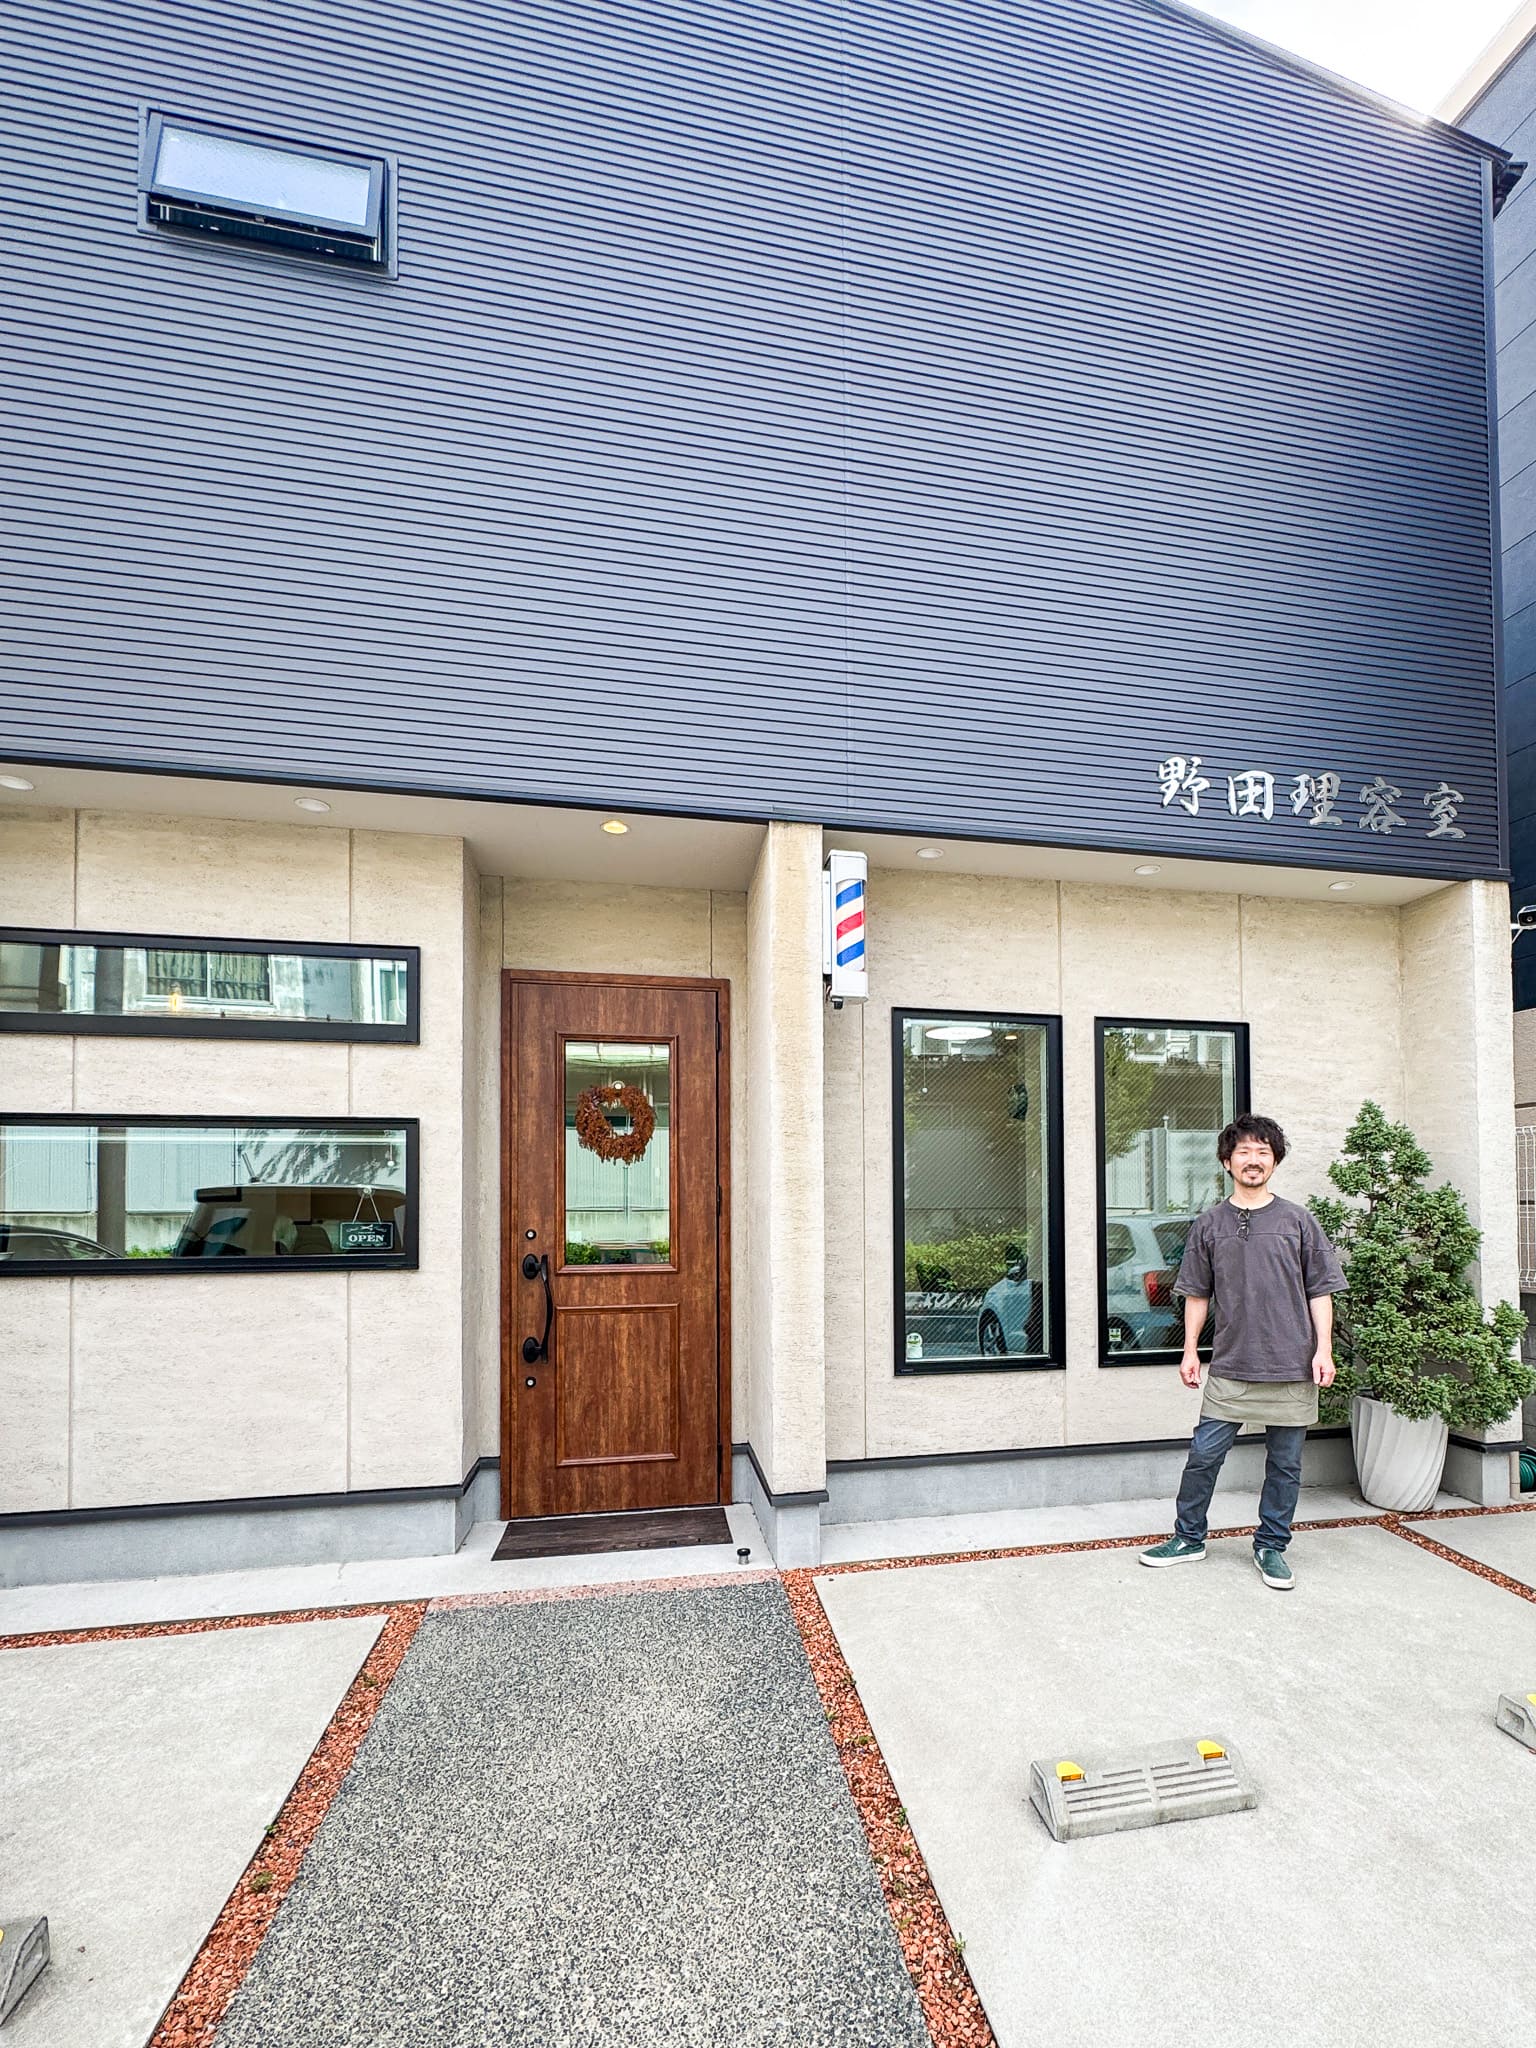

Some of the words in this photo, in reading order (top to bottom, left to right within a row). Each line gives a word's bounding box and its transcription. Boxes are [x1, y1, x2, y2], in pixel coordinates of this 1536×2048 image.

[1158, 756, 1467, 839] 野田理容室
[348, 1234, 385, 1243] OPEN
